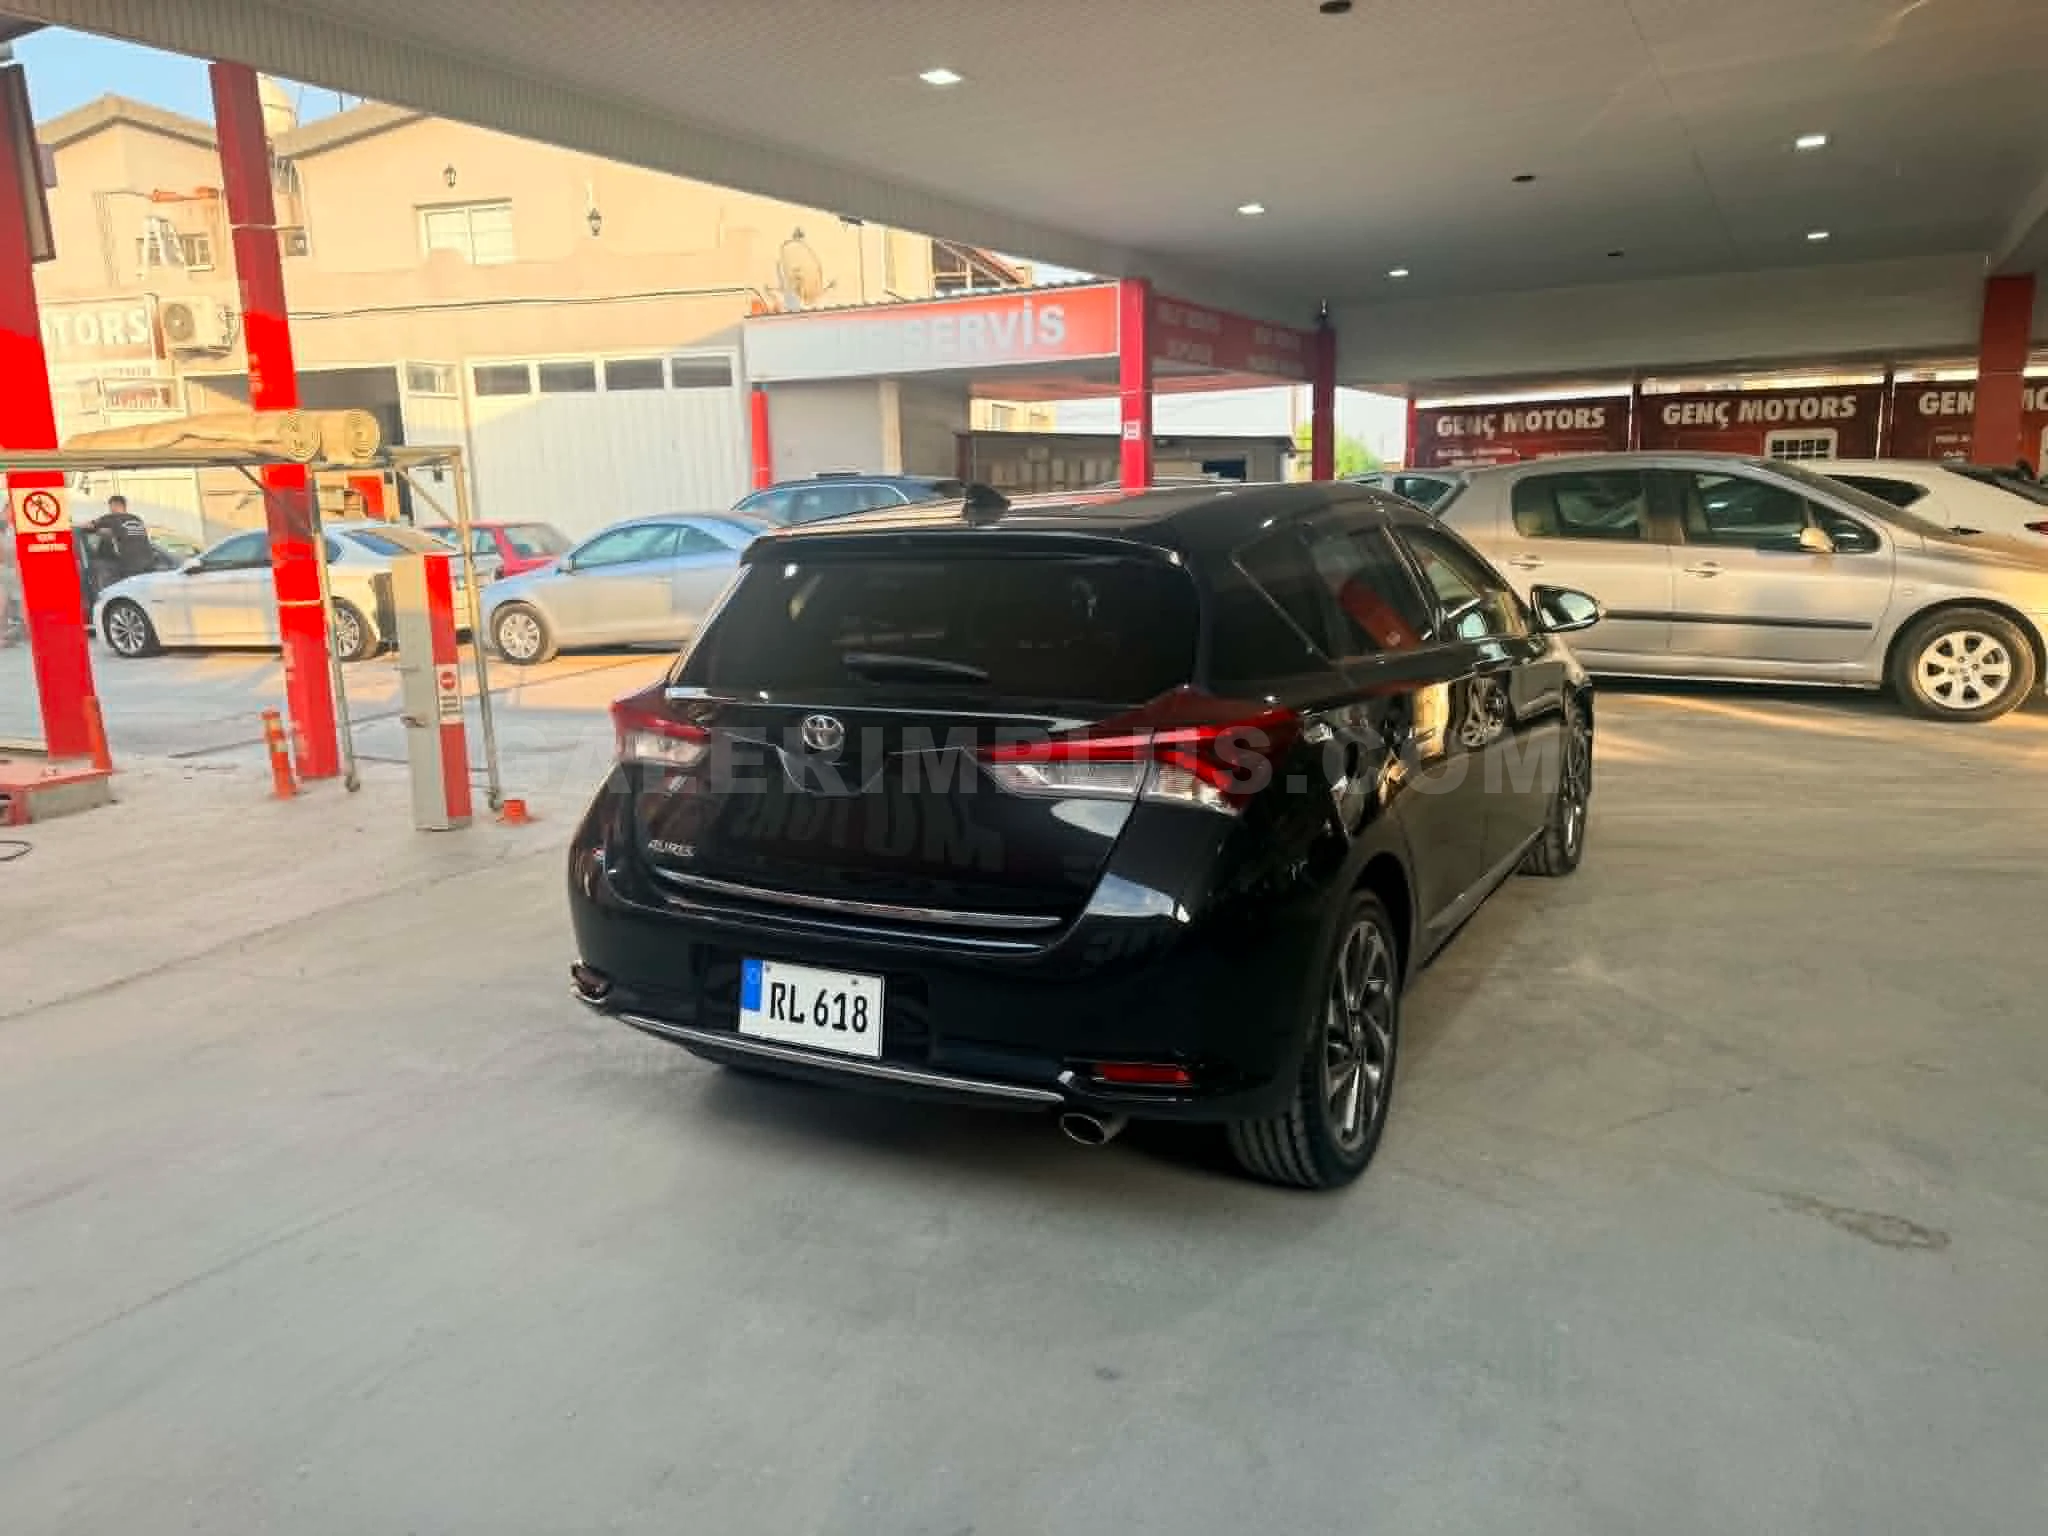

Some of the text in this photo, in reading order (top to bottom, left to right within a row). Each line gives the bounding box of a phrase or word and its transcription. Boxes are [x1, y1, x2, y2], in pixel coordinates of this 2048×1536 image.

[903, 297, 1066, 353] SERVİS
[1663, 395, 1857, 430] GENÇ MOTORS
[1919, 391, 1976, 415] GEN
[1437, 408, 1605, 440] GENÇ MOTORS
[769, 982, 868, 1033] RL 618
